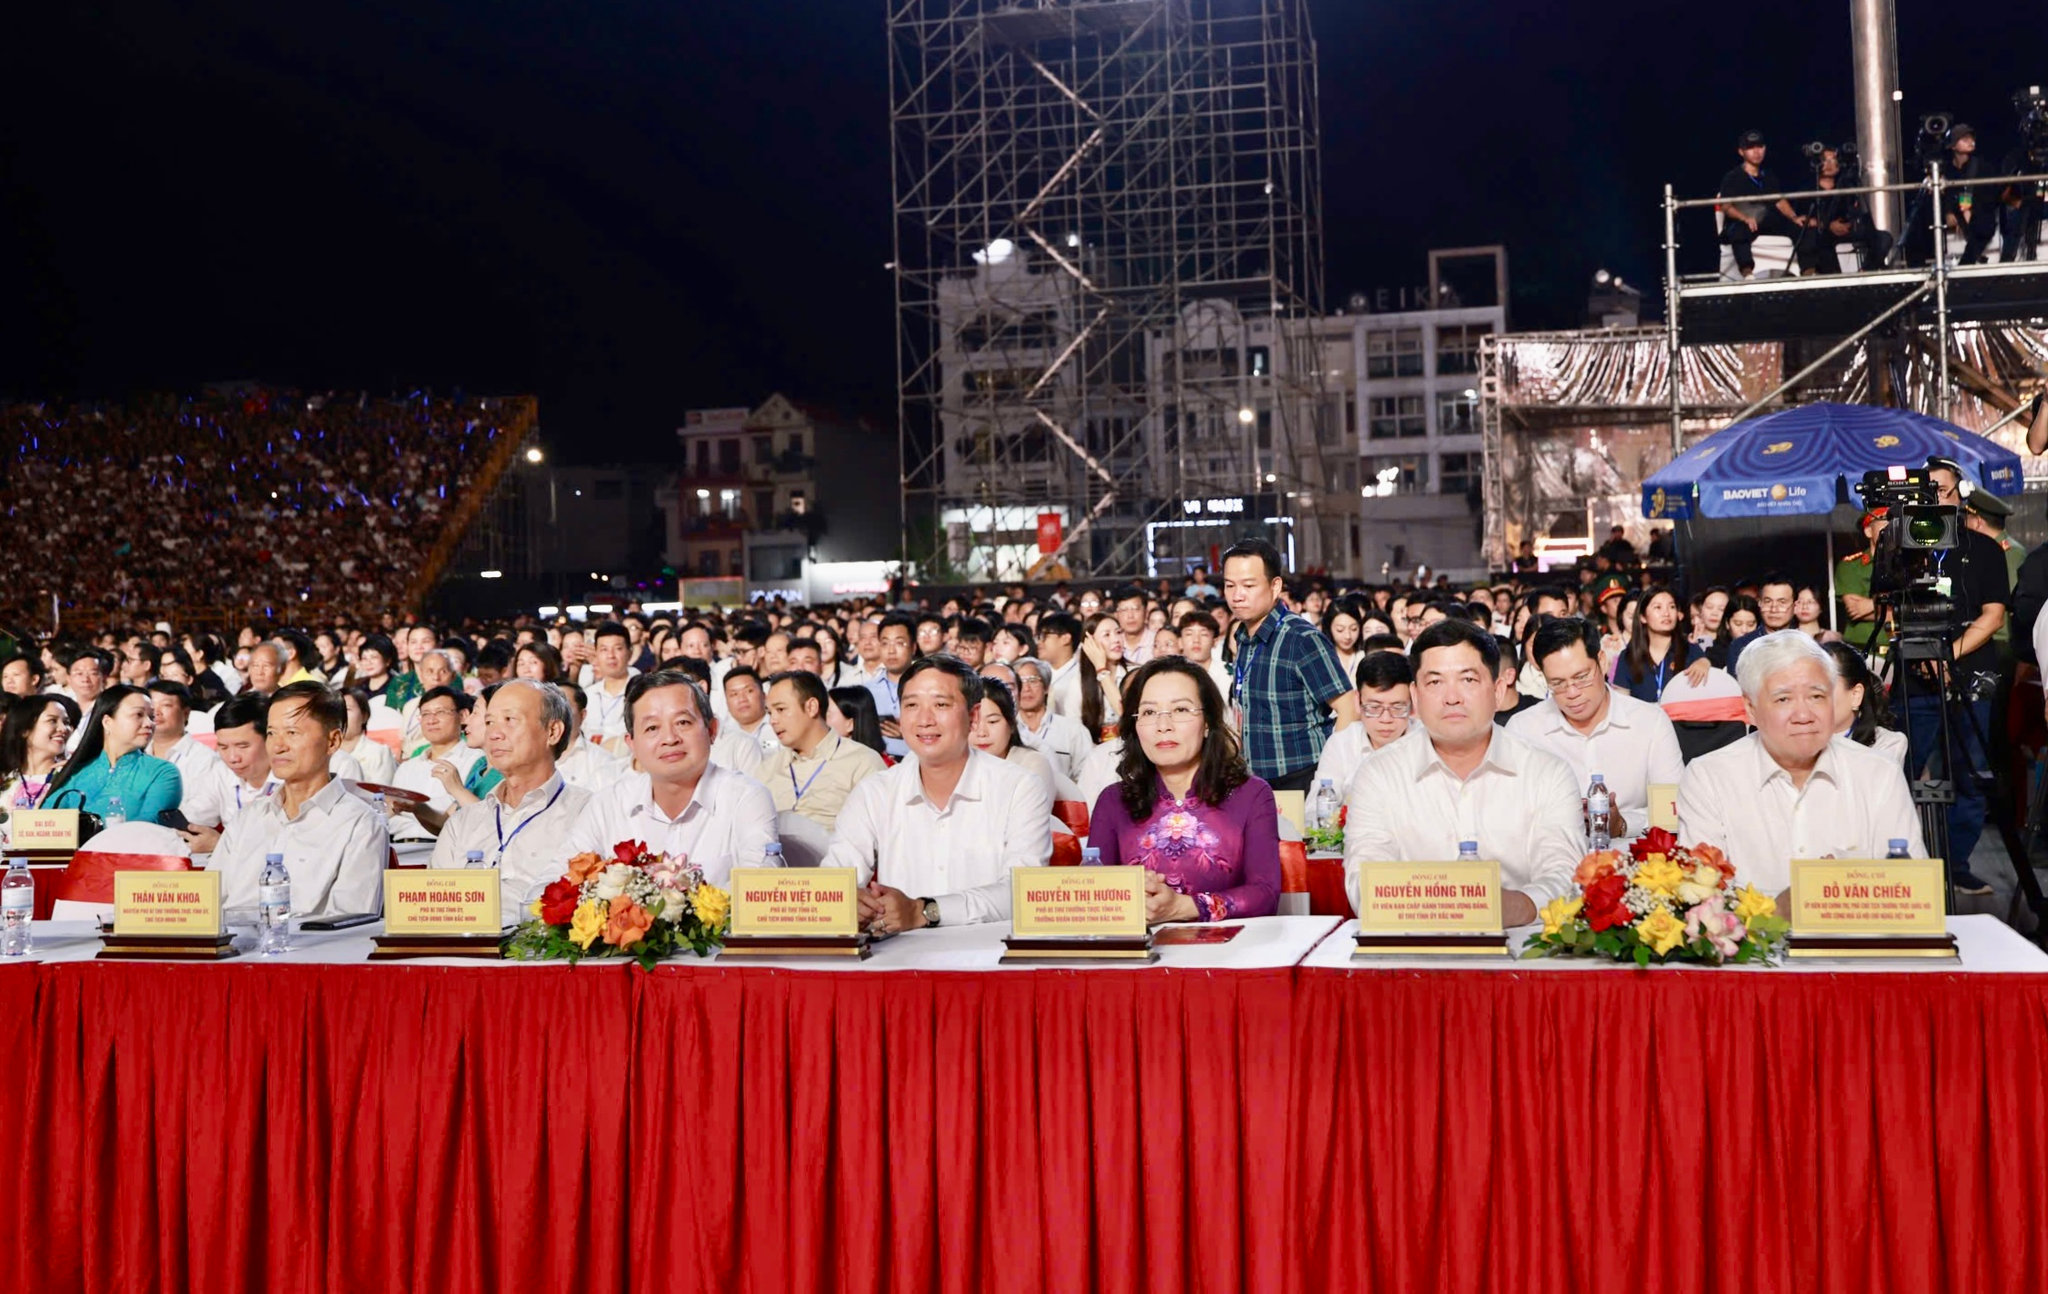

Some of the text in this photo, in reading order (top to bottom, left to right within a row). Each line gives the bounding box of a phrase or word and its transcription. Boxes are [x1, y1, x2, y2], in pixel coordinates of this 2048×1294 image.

[1723, 486, 1807, 500] BAOVIET Life
[132, 890, 200, 903] THÂN VĂN KHOA
[398, 889, 484, 905] PHẠM HOÀNG SƠN
[745, 887, 843, 905] NGUYỄN VIỆT OANH
[1027, 887, 1131, 904] NGUYỄN THỊ HƯƠNG
[1375, 881, 1486, 897] NGUYỄN HỒNG THÁI
[1823, 881, 1911, 898] ĐỖ VĂN CHIẾN
